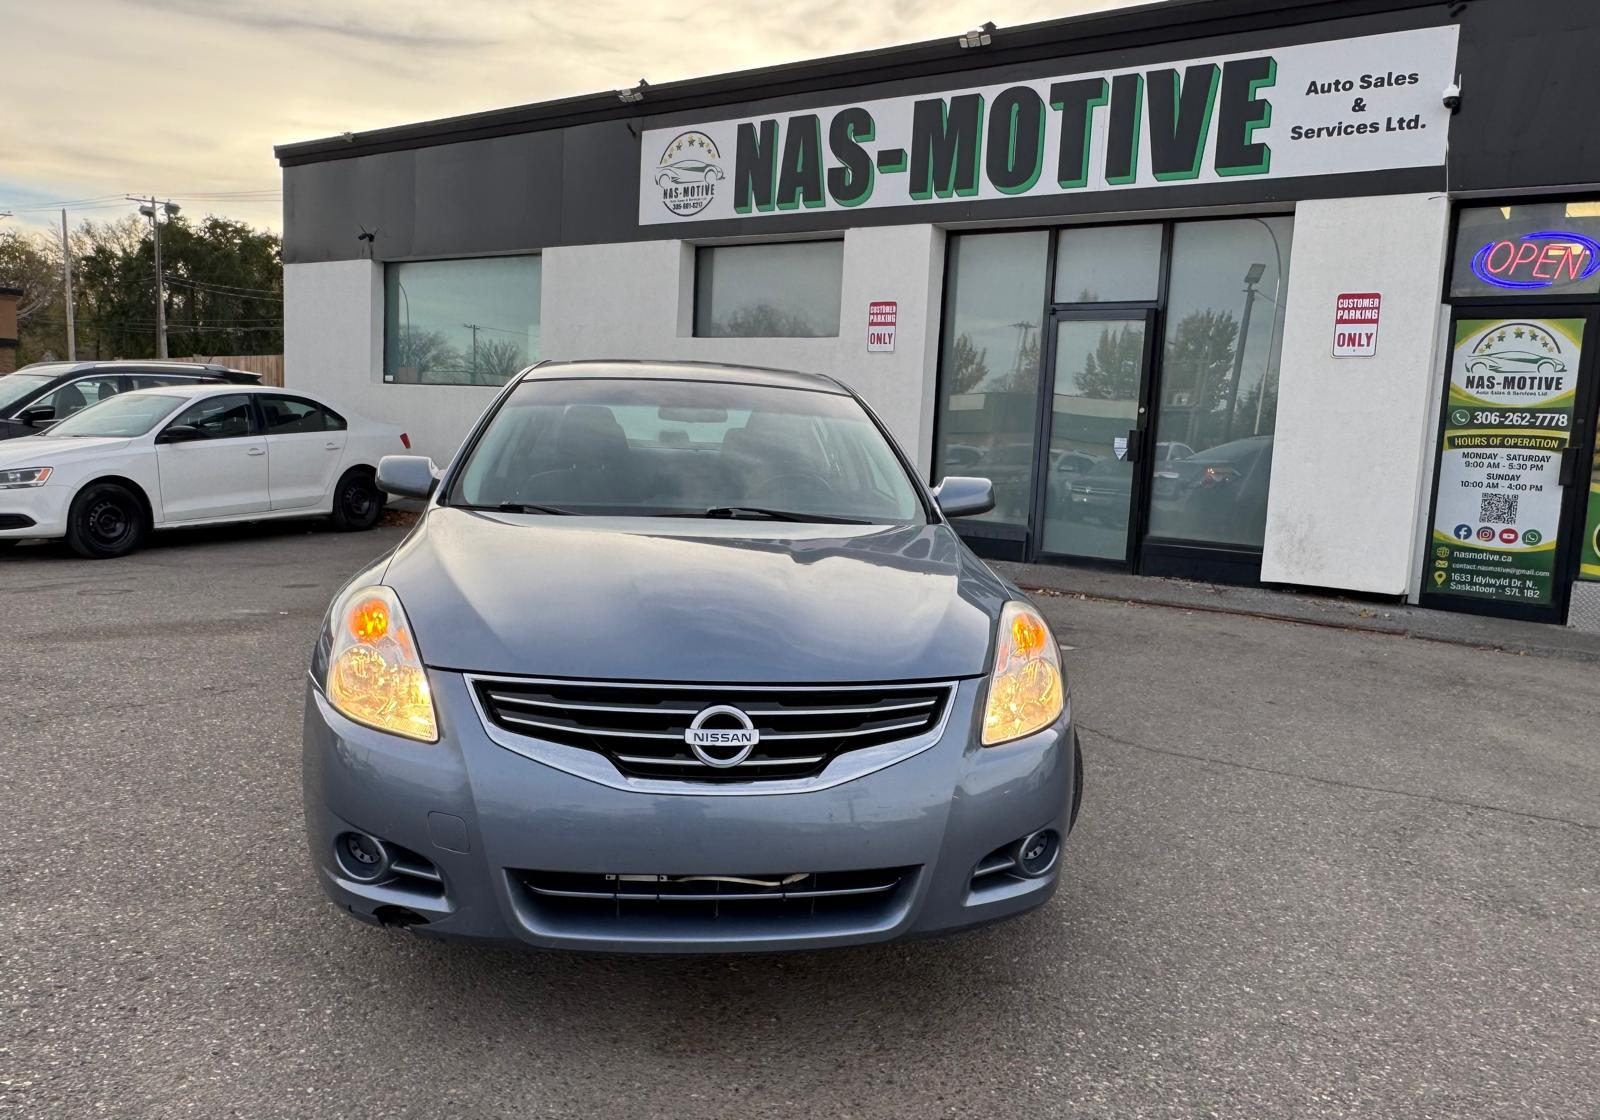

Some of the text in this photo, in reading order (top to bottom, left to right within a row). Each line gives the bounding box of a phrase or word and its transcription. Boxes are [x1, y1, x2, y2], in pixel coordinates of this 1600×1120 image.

[1305, 72, 1419, 96] Auto Sales
[1351, 97, 1367, 112] &
[1290, 114, 1427, 140] Services Ltd.
[734, 56, 1277, 214] NAS-MOTIVE
[664, 184, 714, 200] NAS-MOTIVE
[1487, 240, 1586, 280] OPEN
[1338, 298, 1379, 308] CUSTOMER
[869, 314, 896, 323] PARKING
[1337, 309, 1378, 320] PARKING
[870, 332, 893, 345] ONLY
[1336, 332, 1374, 348] ONLY
[1465, 375, 1564, 391] NAS-MOTIVE
[1473, 411, 1568, 427] 306-262-7778
[1455, 437, 1559, 449] HOURS OF OPERATION
[1461, 452, 1499, 460] MONDAY
[1506, 454, 1552, 463] SATURDAY
[1464, 461, 1484, 469] 9:00
[1486, 472, 1521, 482] SUNDAY
[1460, 480, 1484, 489] 10:00
[1506, 482, 1528, 490] 4:00
[1530, 484, 1543, 492] PM
[1453, 551, 1512, 562] nasmotive.ca
[1451, 573, 1471, 582] 1633
[1472, 575, 1509, 587] Idylwyld
[1511, 578, 1523, 588] Dr.
[1450, 582, 1496, 594] Saskatoon
[1504, 588, 1521, 596] S7L
[1524, 589, 1540, 598] 1B2
[693, 732, 752, 743] NISSAN
